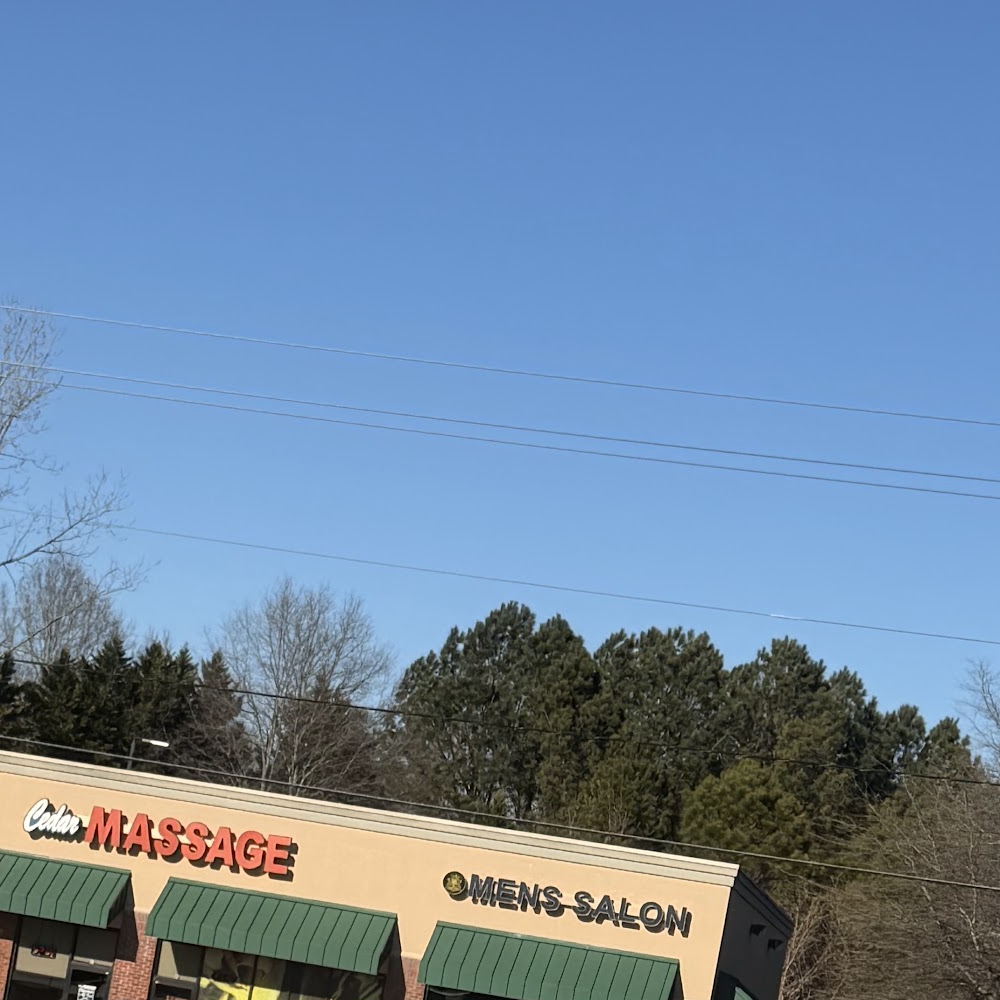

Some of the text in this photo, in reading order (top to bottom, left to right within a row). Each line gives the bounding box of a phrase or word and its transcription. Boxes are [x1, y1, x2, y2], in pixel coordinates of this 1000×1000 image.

[23, 797, 293, 875] Cedar MASSAGE
[468, 873, 689, 932] MENS SALON
